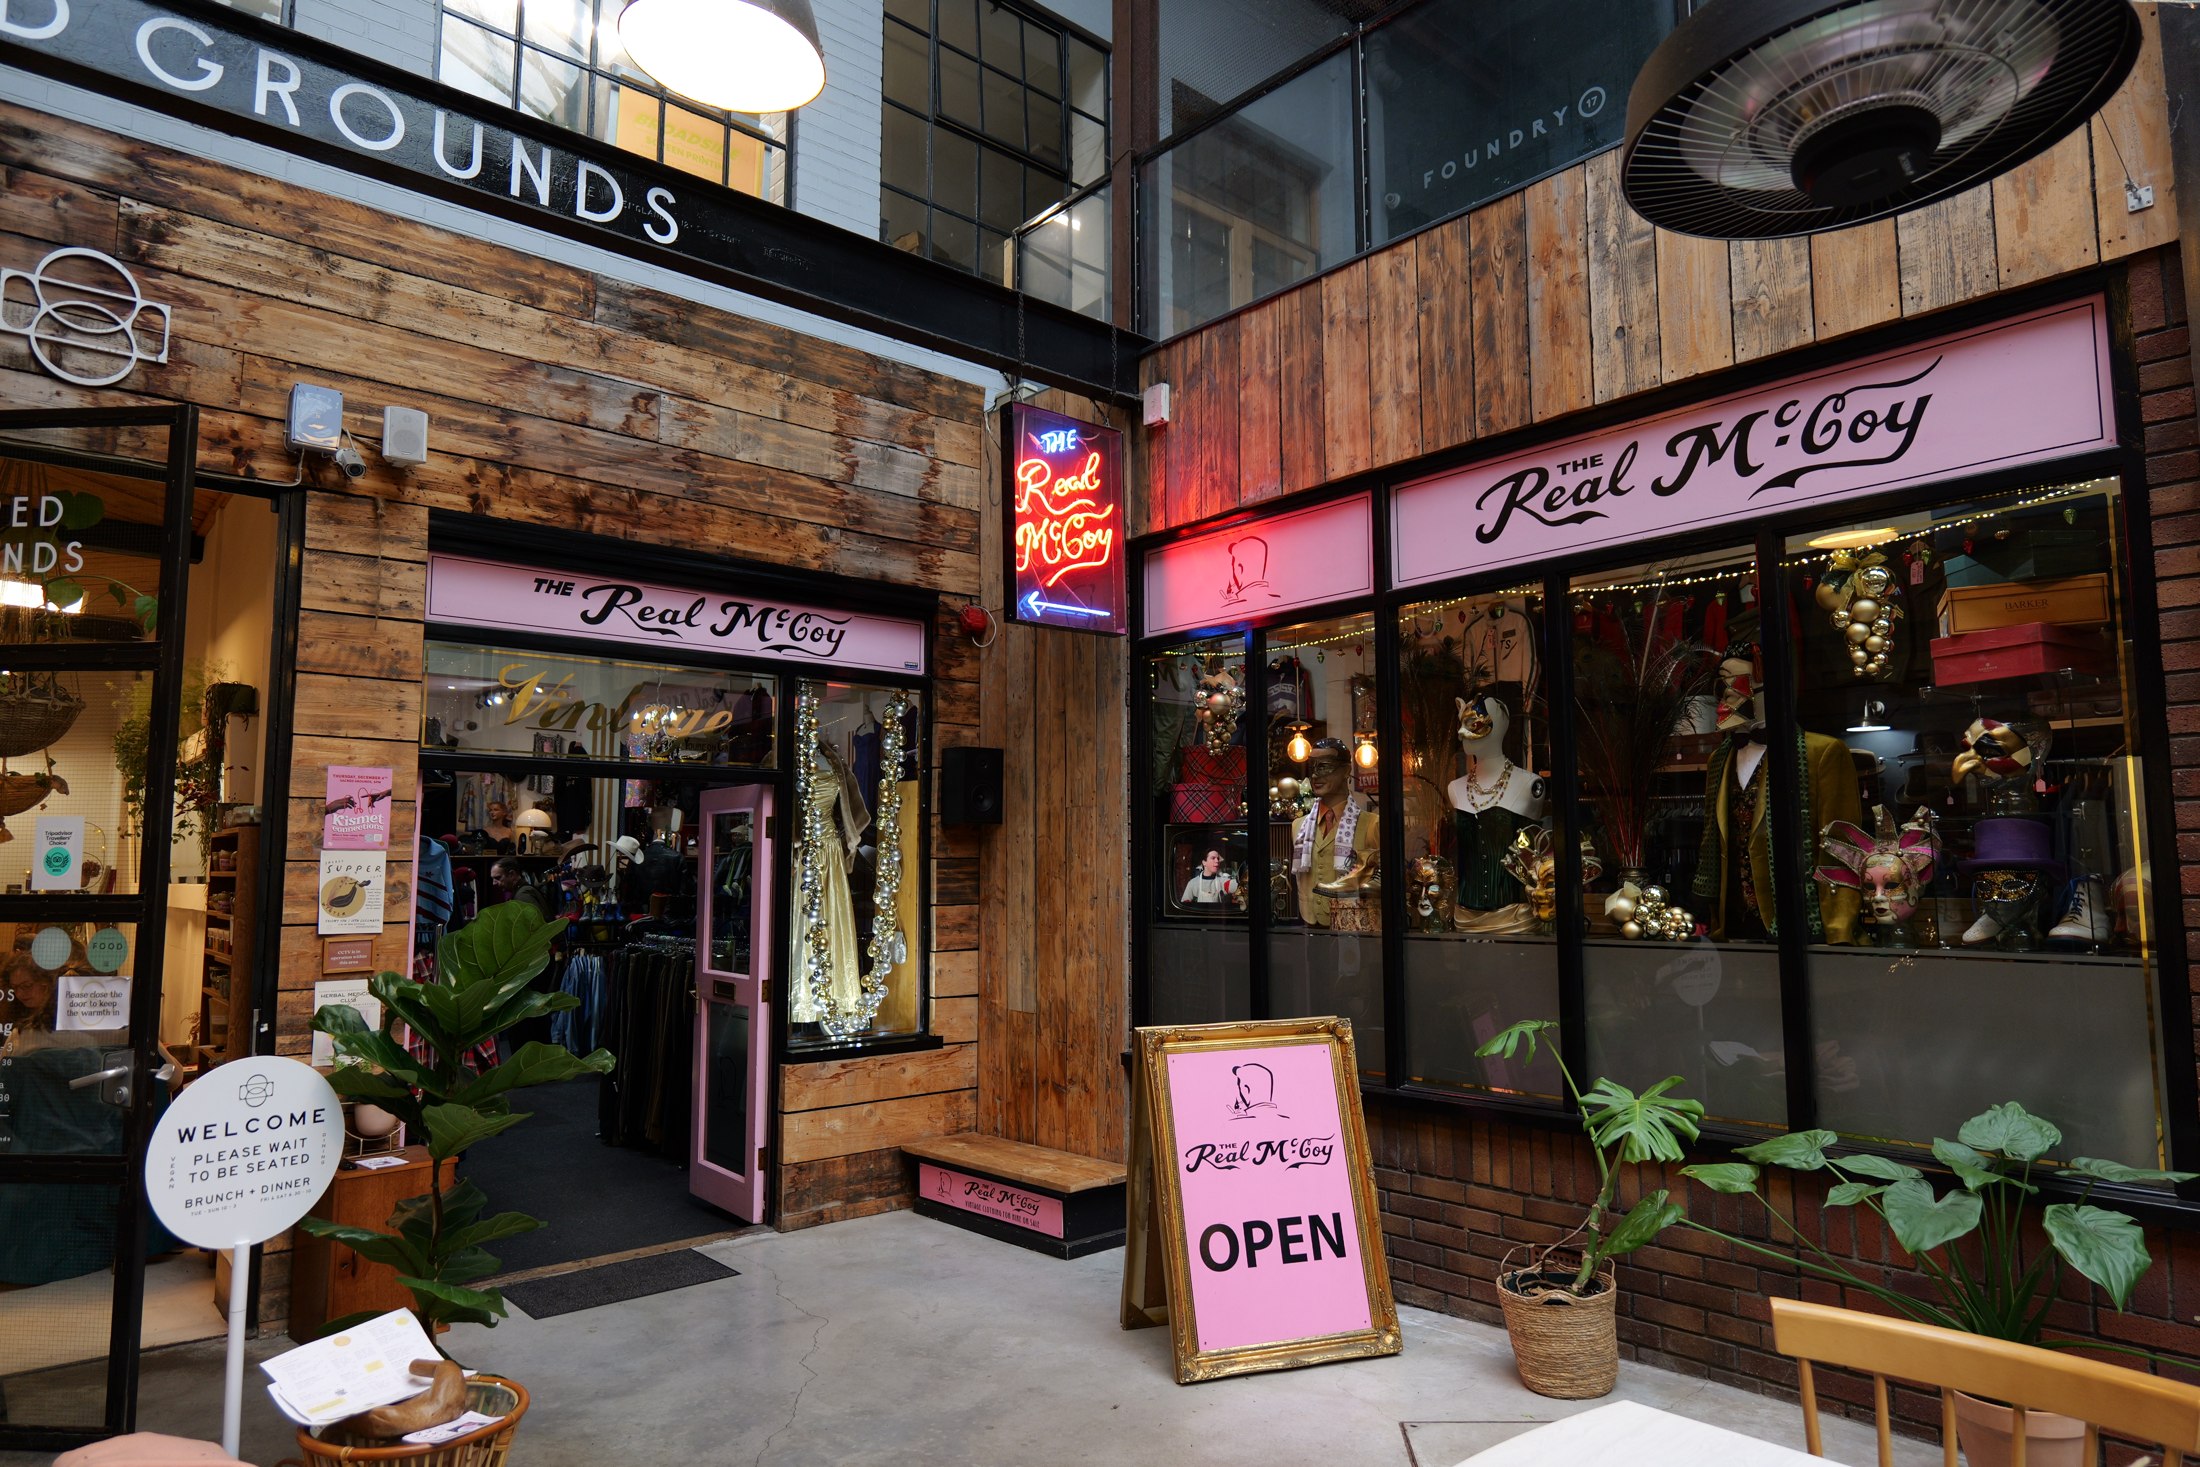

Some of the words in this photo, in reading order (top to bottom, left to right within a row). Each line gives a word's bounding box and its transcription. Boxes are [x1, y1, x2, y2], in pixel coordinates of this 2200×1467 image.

[135, 16, 679, 244] GROUNDS
[1423, 105, 1568, 190] FOUNDRY
[1585, 96, 1599, 109] 17
[1040, 428, 1078, 454] THE
[1475, 440, 1638, 544] Real
[1650, 354, 1944, 502] McCoy
[1556, 453, 1604, 476] THE
[1015, 452, 1101, 516] Real
[1015, 503, 1114, 587] McCoy
[533, 577, 576, 597] THE
[579, 583, 706, 639] Real
[709, 601, 852, 657] McCoy
[2004, 598, 2049, 610] BARKER
[498, 663, 735, 756] Vintage
[332, 813, 385, 827] Kismet
[326, 864, 381, 874] SUPPER
[92, 942, 123, 950] FOOD
[65, 990, 89, 999] Please
[89, 989, 108, 998] close
[108, 990, 123, 998] the
[89, 999, 97, 1007] to
[98, 999, 118, 1009] keep
[66, 1009, 78, 1017] the
[80, 1008, 111, 1017] warmth
[112, 1008, 120, 1016] in
[178, 1108, 326, 1143] WELCOME
[193, 1145, 262, 1166] PLEASE
[269, 1137, 308, 1153] WAIT
[1185, 1140, 1250, 1173] Real
[1252, 1133, 1335, 1171] McCoy
[1218, 1142, 1238, 1150] THE
[168, 1156, 176, 1190] VEGAN
[189, 1170, 209, 1183] TO
[217, 1165, 239, 1179] BE
[246, 1153, 310, 1174] SEATED
[184, 1189, 244, 1209] BRUNCH
[261, 1177, 311, 1194] DINNER
[964, 1181, 996, 1202] Real
[996, 1190, 1041, 1216] McCoy
[982, 1205, 1002, 1217] CLOTHING
[1199, 1212, 1347, 1273] OPEN
